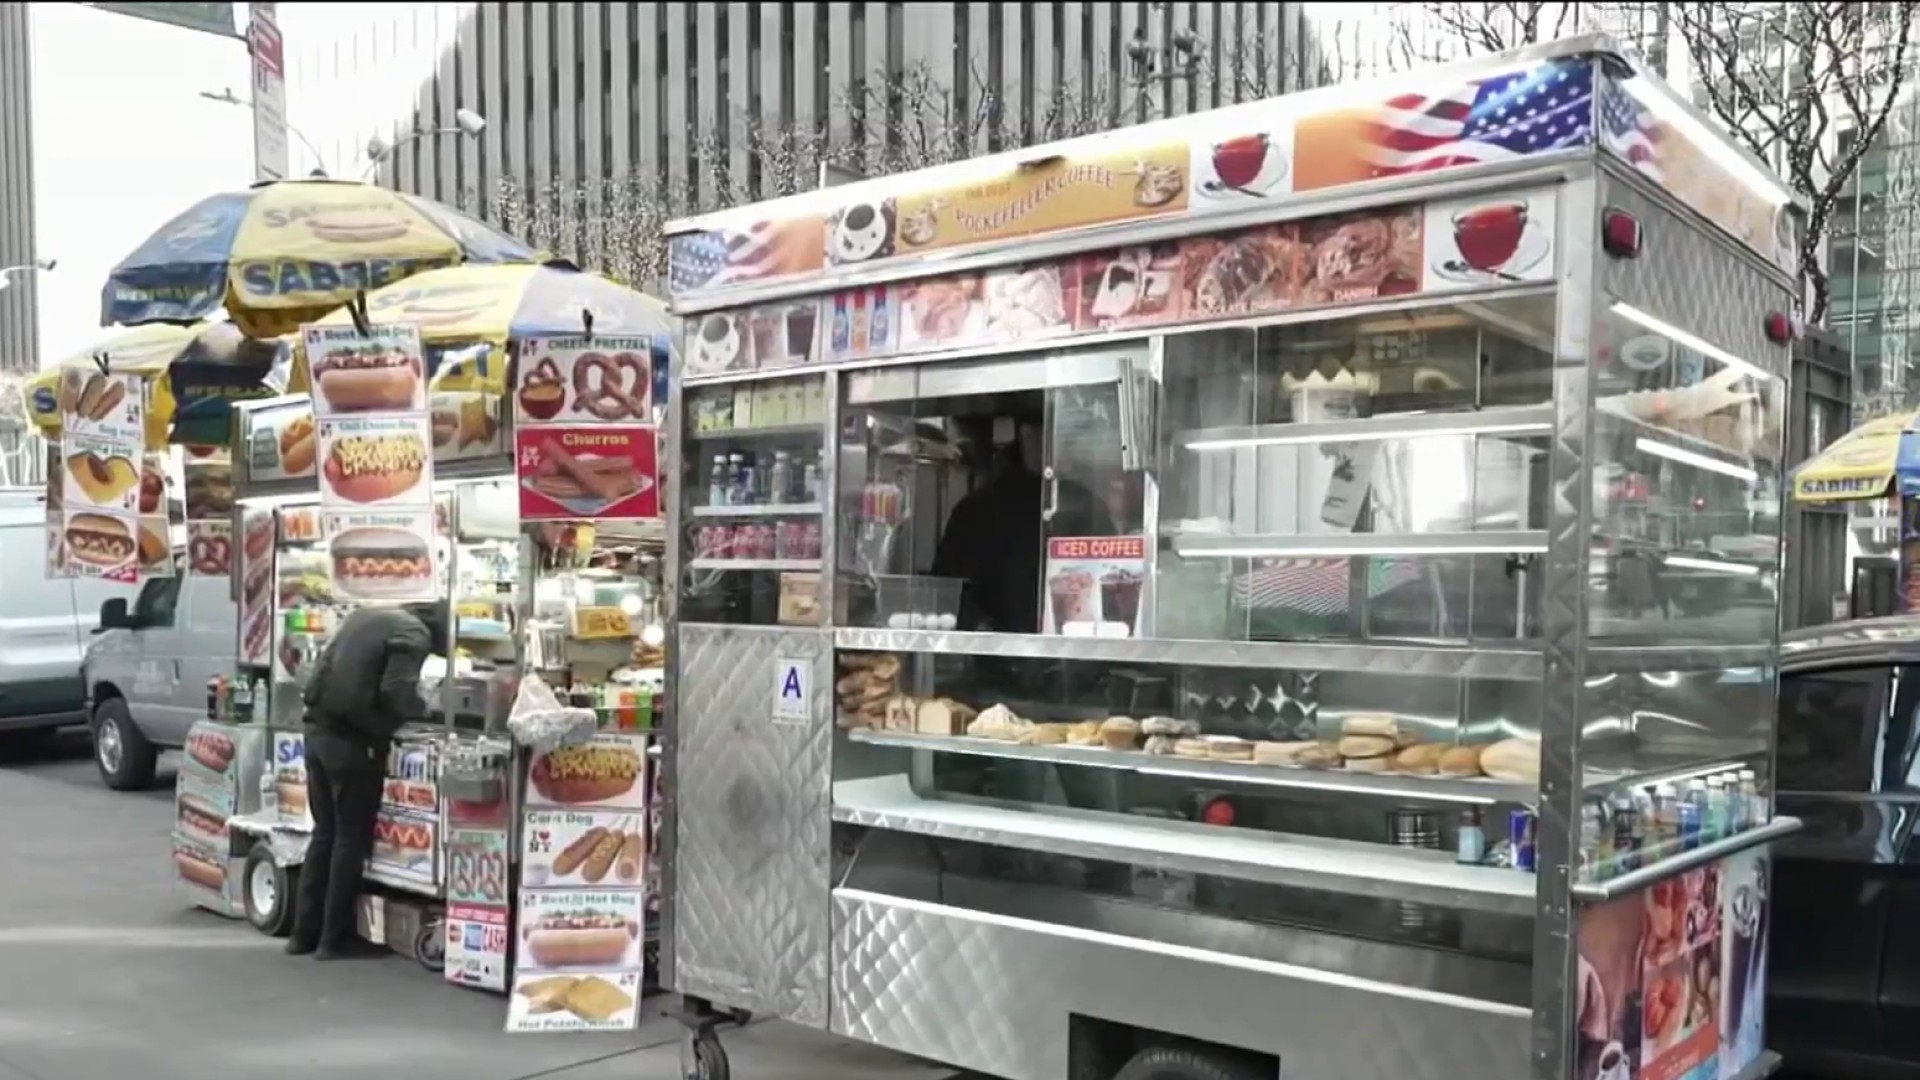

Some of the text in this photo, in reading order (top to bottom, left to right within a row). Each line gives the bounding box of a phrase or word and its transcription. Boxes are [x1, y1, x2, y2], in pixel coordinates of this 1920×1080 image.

[594, 337, 648, 350] PRETZEL
[562, 432, 630, 446] Churros
[1056, 540, 1141, 557] ICED COFFEE
[781, 666, 803, 699] A
[565, 813, 594, 825] Dog
